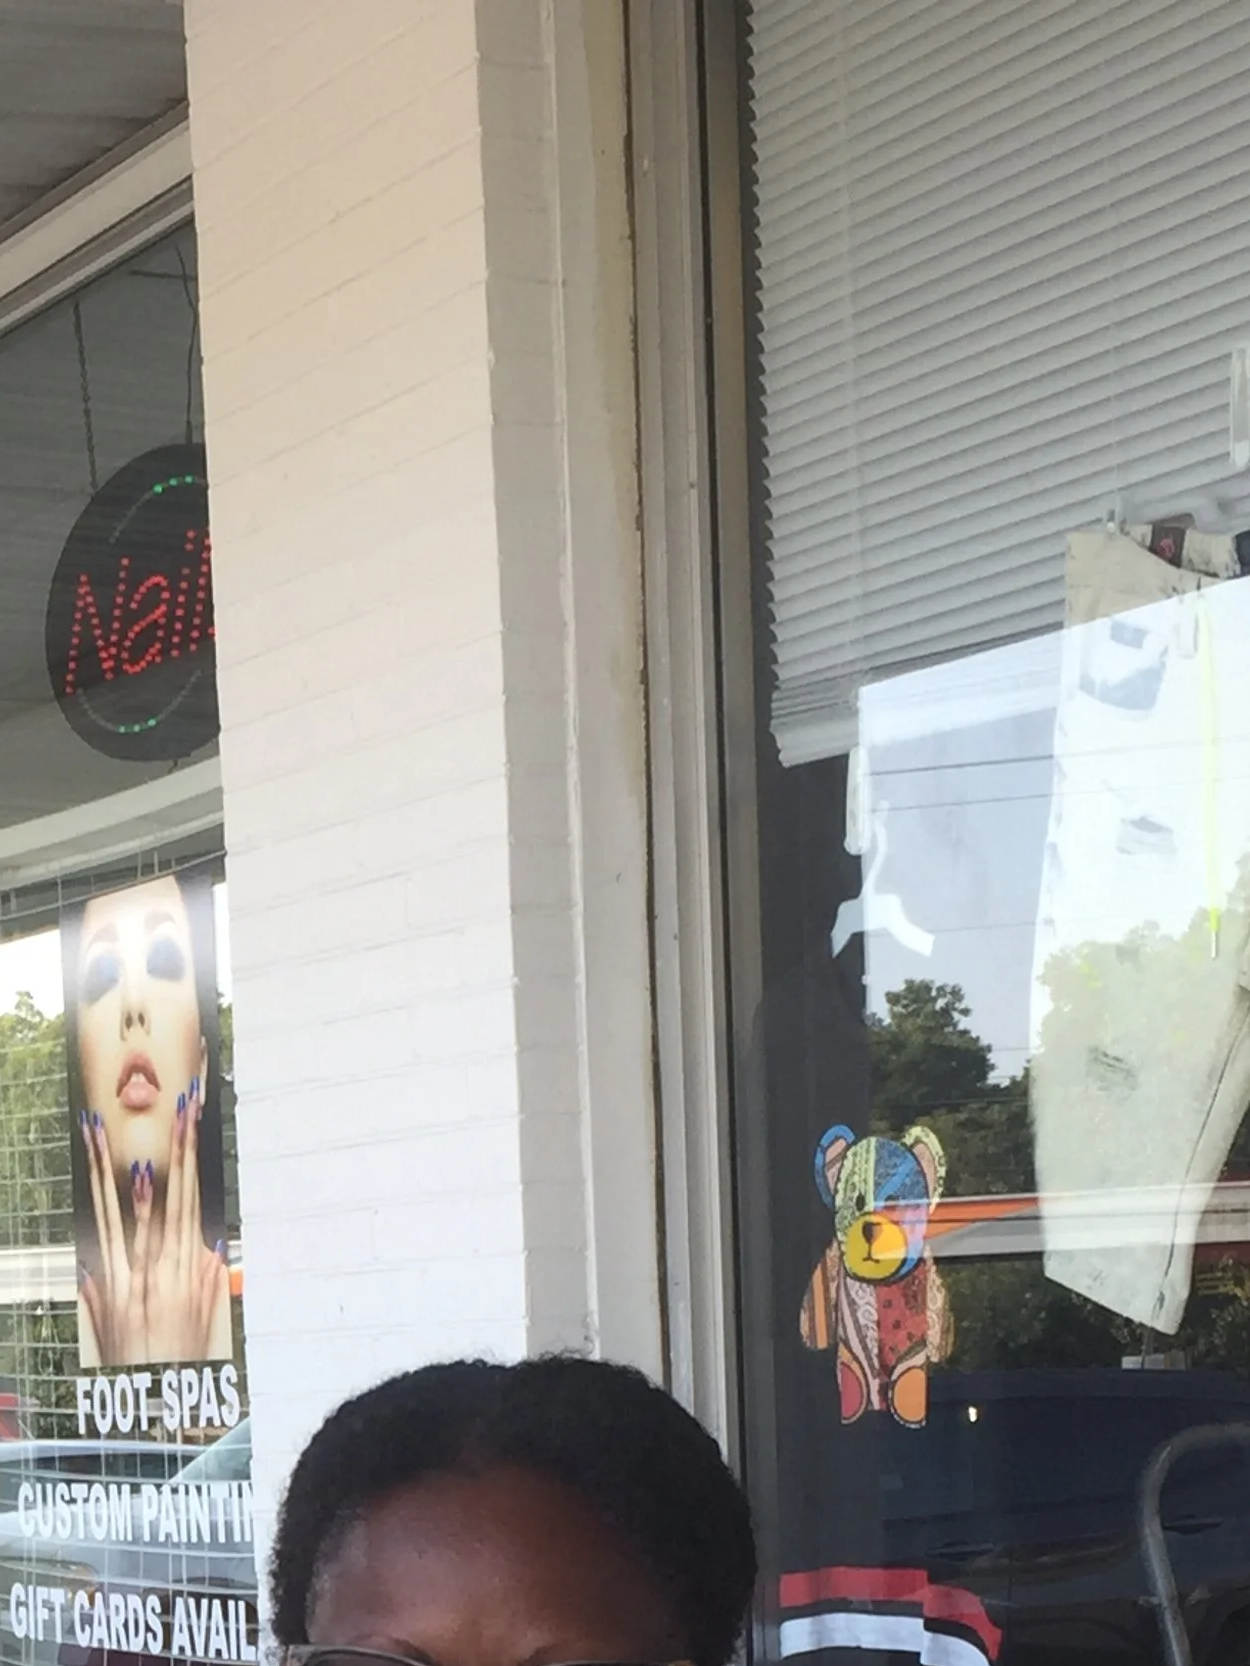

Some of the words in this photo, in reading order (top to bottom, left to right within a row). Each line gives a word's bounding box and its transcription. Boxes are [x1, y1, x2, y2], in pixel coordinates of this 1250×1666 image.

[64, 528, 217, 694] Nail
[77, 1371, 151, 1435] FOOT
[161, 1364, 240, 1432] SPAS
[18, 1482, 133, 1542] CUSTOM
[9, 1582, 65, 1644] GIFT
[73, 1590, 164, 1655] CARDS
[171, 1596, 257, 1661] AVAIL
